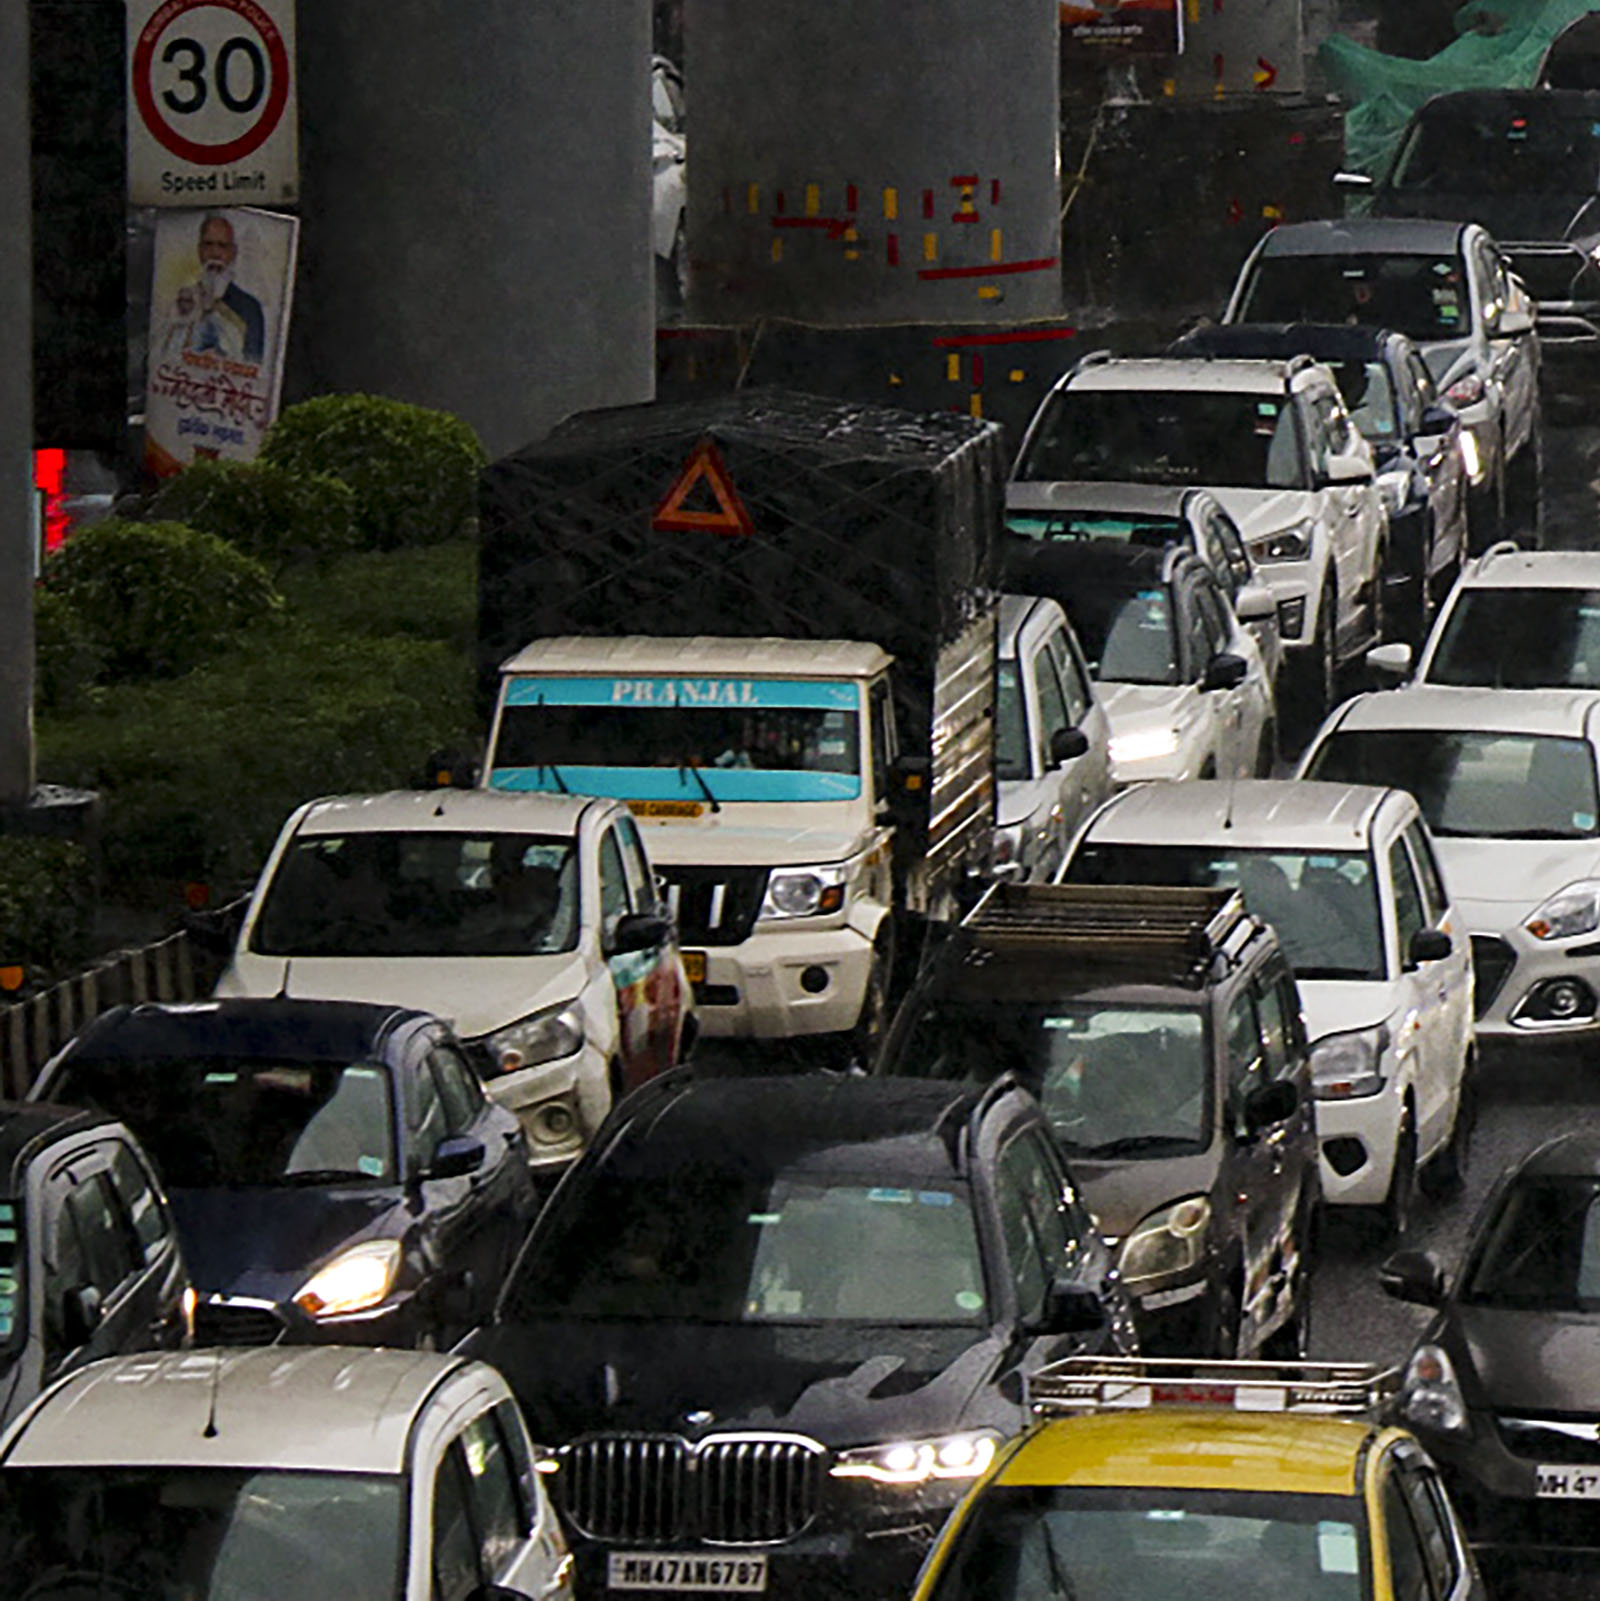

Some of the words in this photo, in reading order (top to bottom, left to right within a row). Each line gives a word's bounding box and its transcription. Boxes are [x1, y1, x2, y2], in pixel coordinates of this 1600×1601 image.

[162, 37, 265, 114] 30
[161, 171, 217, 193] Speed
[223, 171, 265, 190] Limit
[612, 679, 760, 704] PRANJAL
